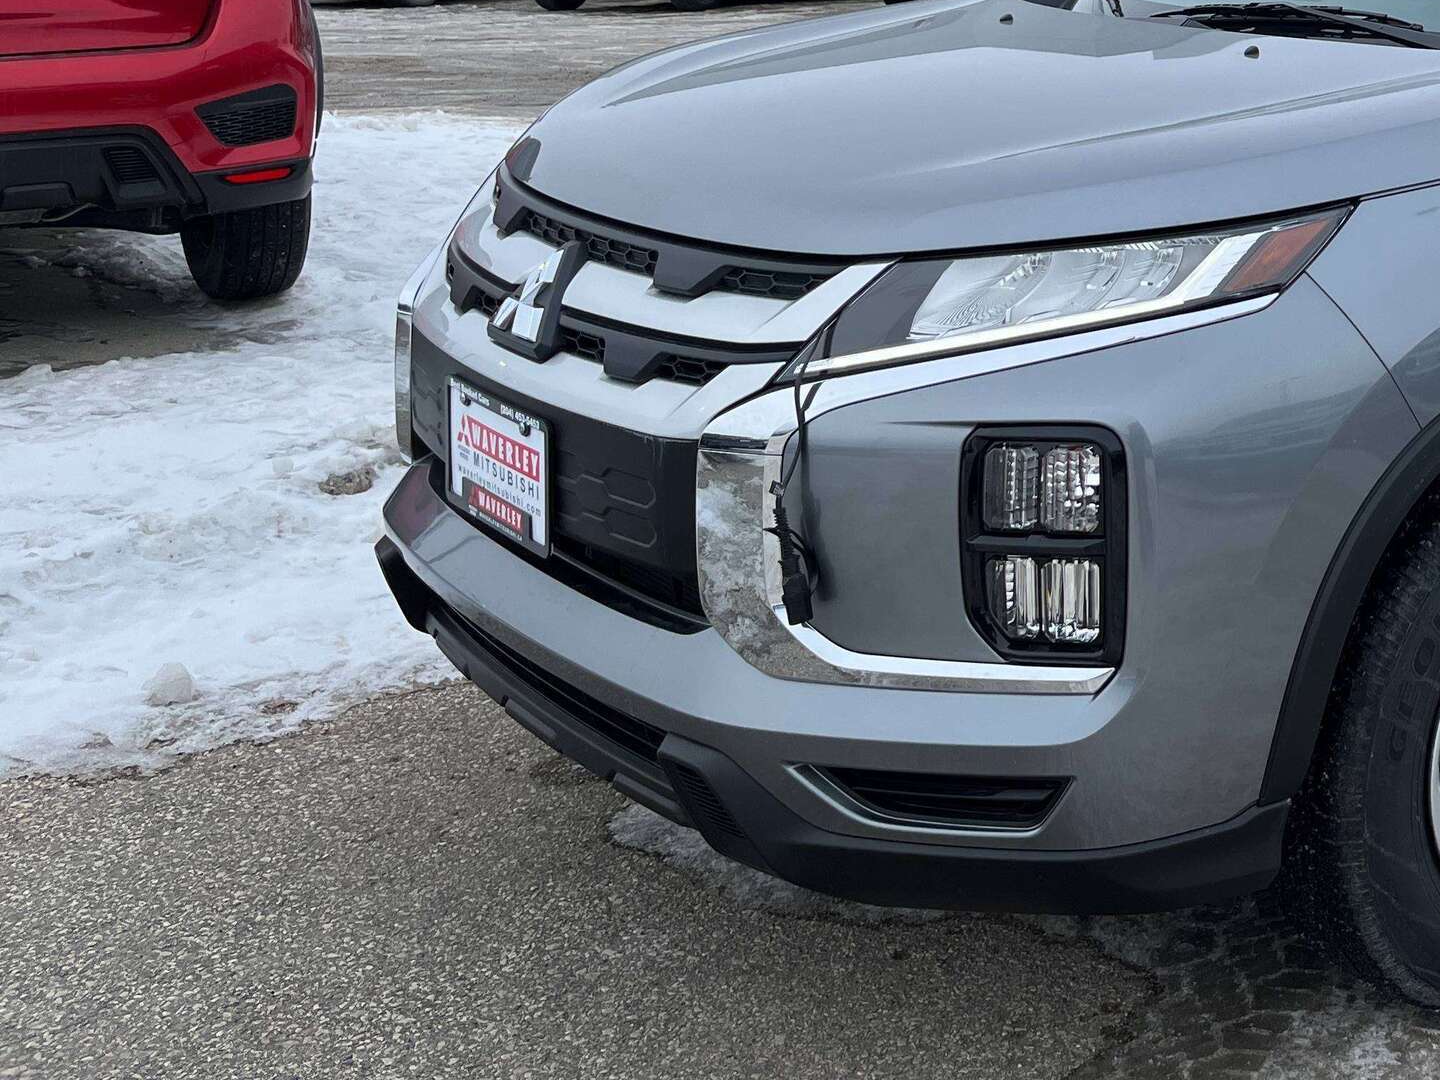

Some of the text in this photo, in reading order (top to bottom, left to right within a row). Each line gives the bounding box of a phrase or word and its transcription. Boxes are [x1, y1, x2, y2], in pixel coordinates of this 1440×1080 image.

[471, 422, 539, 477] WAVERLEY
[473, 451, 539, 500] MITSUBISHI
[478, 490, 521, 529] WAVERLEY
